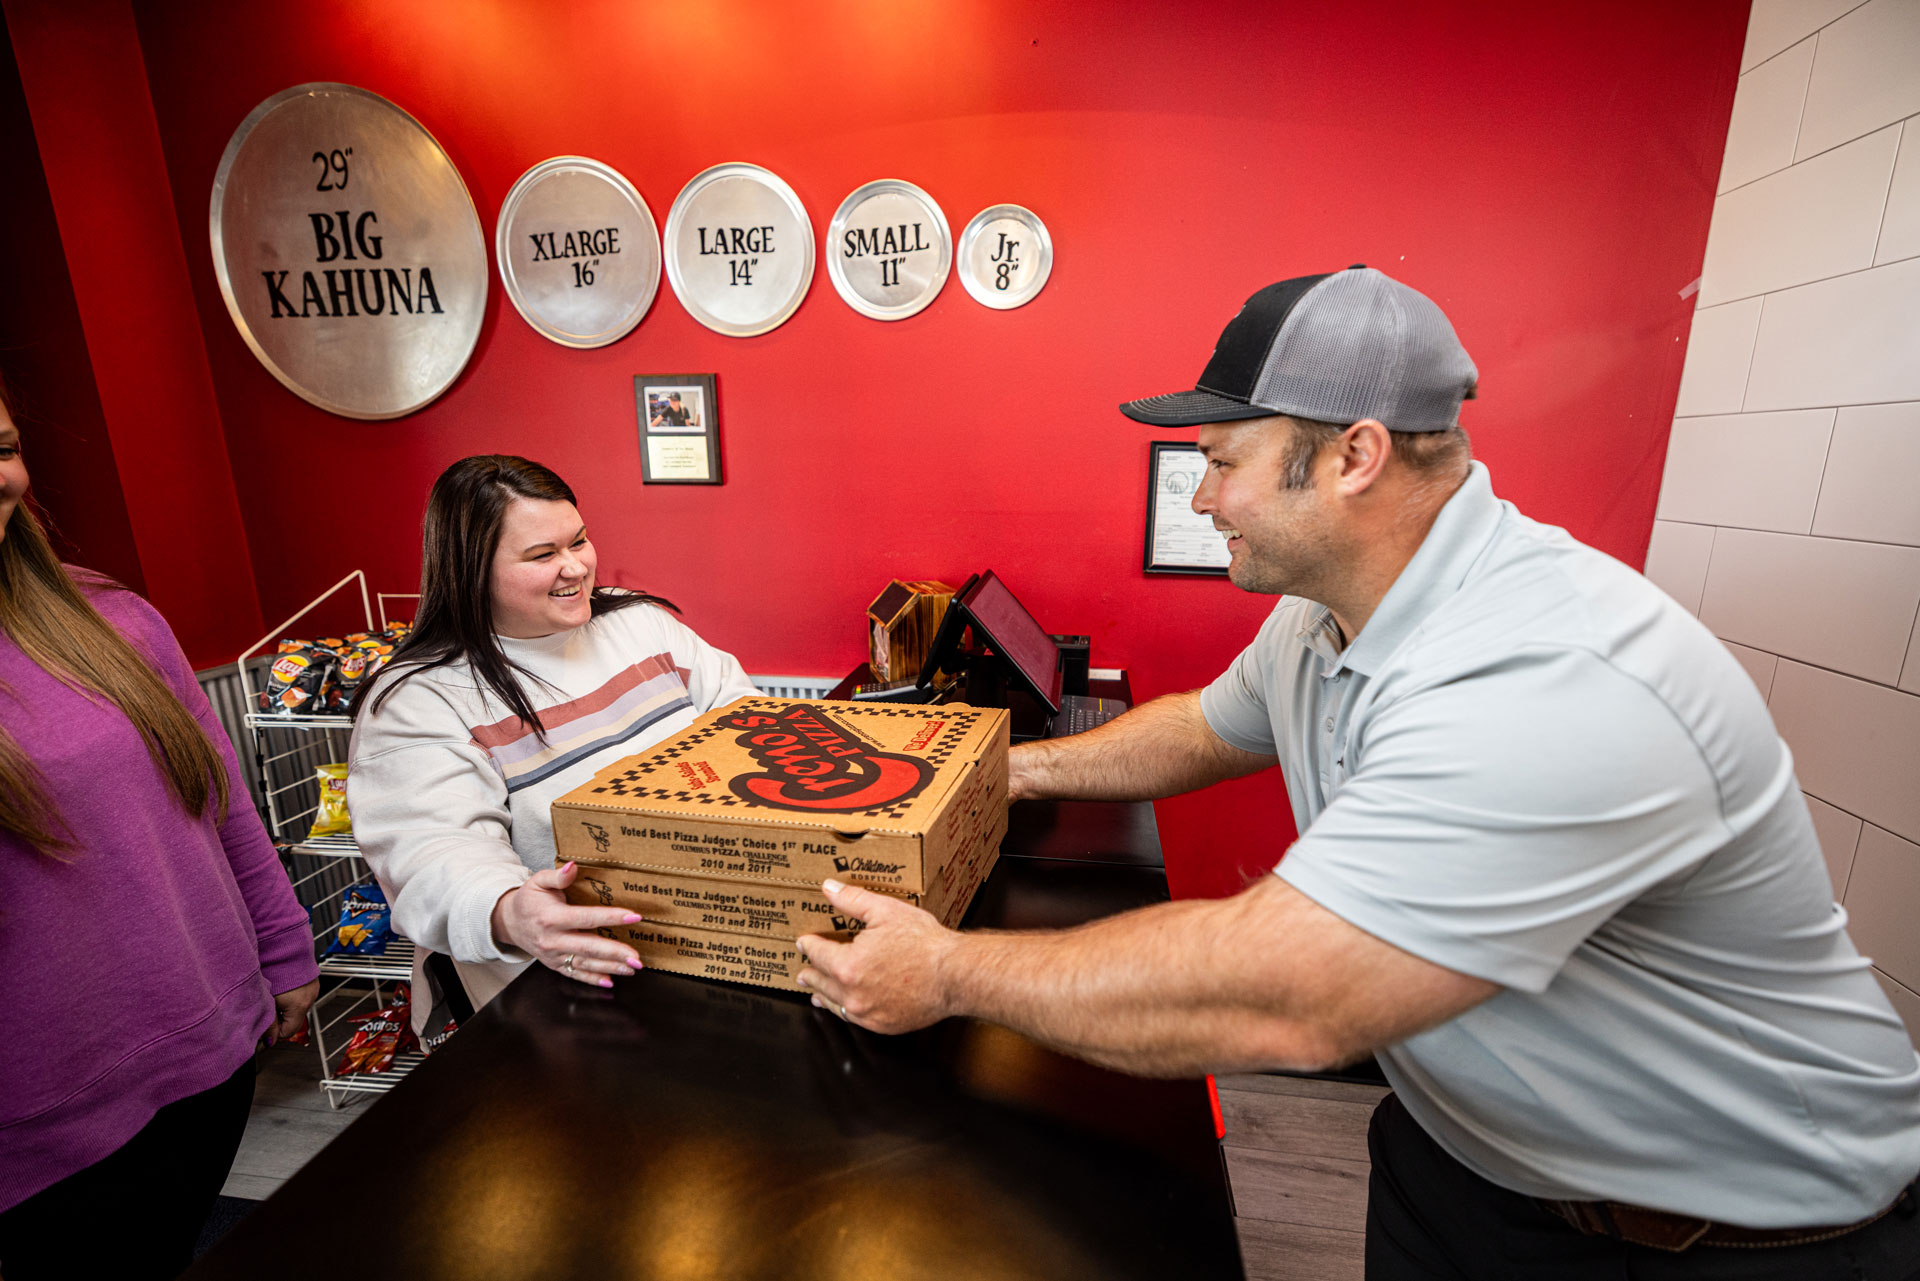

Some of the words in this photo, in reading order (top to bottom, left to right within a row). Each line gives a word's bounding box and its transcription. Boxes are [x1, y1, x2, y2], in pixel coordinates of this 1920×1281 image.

[312, 147, 353, 192] 29"
[308, 211, 383, 262] BIG
[529, 228, 621, 262] XLARGE
[697, 226, 775, 255] LARGE
[844, 223, 930, 258] SMALL
[990, 233, 1020, 263] Jr.
[572, 260, 600, 288] 16"
[729, 259, 758, 286] 14"
[880, 257, 907, 287] 11"
[995, 264, 1020, 290] 8"
[262, 267, 445, 319] KAHUNA
[784, 709, 864, 758] PIZZA
[620, 826, 647, 838] Voted
[650, 829, 671, 840] Best
[674, 832, 699, 843] Pizza
[702, 834, 739, 848] Judges'
[742, 838, 777, 850] Choice
[803, 843, 837, 856] PLACE
[671, 843, 711, 855] COLUMBUS
[712, 847, 741, 857] PIZZA
[742, 850, 788, 861] CHALLENGE
[701, 858, 724, 869] 2010
[727, 862, 745, 871] and
[748, 862, 771, 874] 2011
[850, 857, 907, 874] Children's
[623, 882, 649, 893] Voted
[652, 885, 673, 897] Best
[675, 888, 700, 899] Pizza
[703, 891, 739, 904] Judges'
[743, 896, 776, 908] Choice
[801, 902, 834, 914] PLACE
[673, 899, 711, 910] COLUMBUS
[713, 904, 741, 914] PIZZA
[742, 908, 788, 919] CHALLENGE
[702, 914, 725, 924] 2010
[728, 917, 745, 927] and
[748, 920, 771, 930] 2011
[629, 930, 654, 942] Voted
[657, 933, 677, 946] Best
[680, 937, 703, 949] Pizza
[706, 942, 742, 955] Judges'
[745, 946, 777, 960] Choice
[677, 949, 714, 961] COLUMBUS
[716, 954, 743, 965] PIZZA
[744, 959, 788, 972] CHALLENGE
[704, 964, 727, 975] 2010
[729, 968, 746, 978] and
[749, 971, 771, 982] 2011
